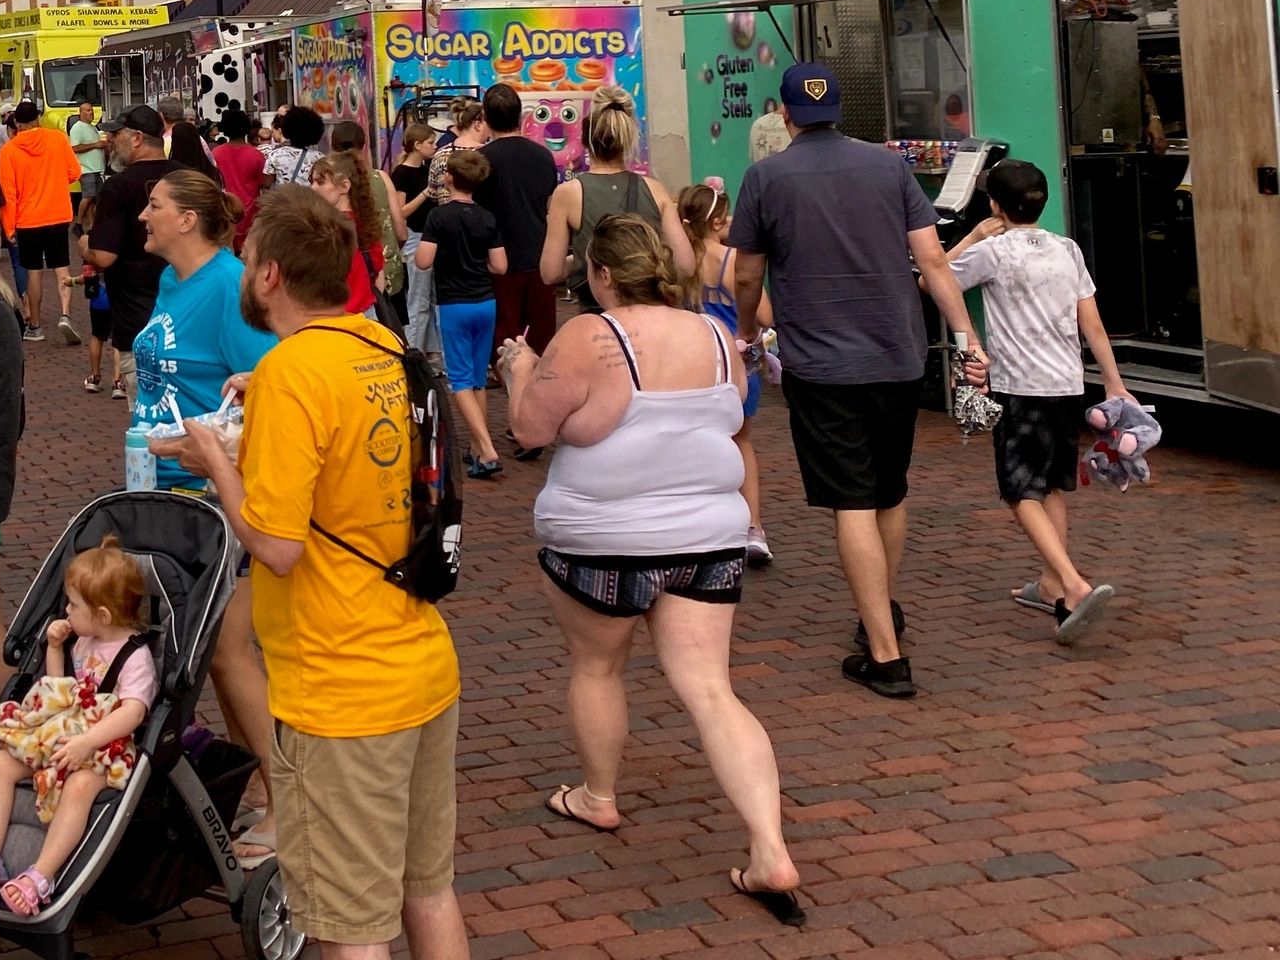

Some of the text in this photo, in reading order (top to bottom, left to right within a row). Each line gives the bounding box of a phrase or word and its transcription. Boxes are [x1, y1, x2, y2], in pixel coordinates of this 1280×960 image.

[77, 8, 123, 16] SHAWARMA
[130, 7, 158, 15] KEBABS
[56, 19, 86, 27] FALAFEL
[93, 18, 119, 26] BOWLS
[129, 17, 150, 26] MORE
[387, 21, 626, 61] SUGAR ADDICTS
[716, 54, 755, 76] Gluten
[723, 77, 748, 98] Free
[158, 359, 178, 374] 25
[384, 356, 401, 369] SPO
[382, 377, 407, 395] ANYT
[202, 805, 237, 871] BRAVO
